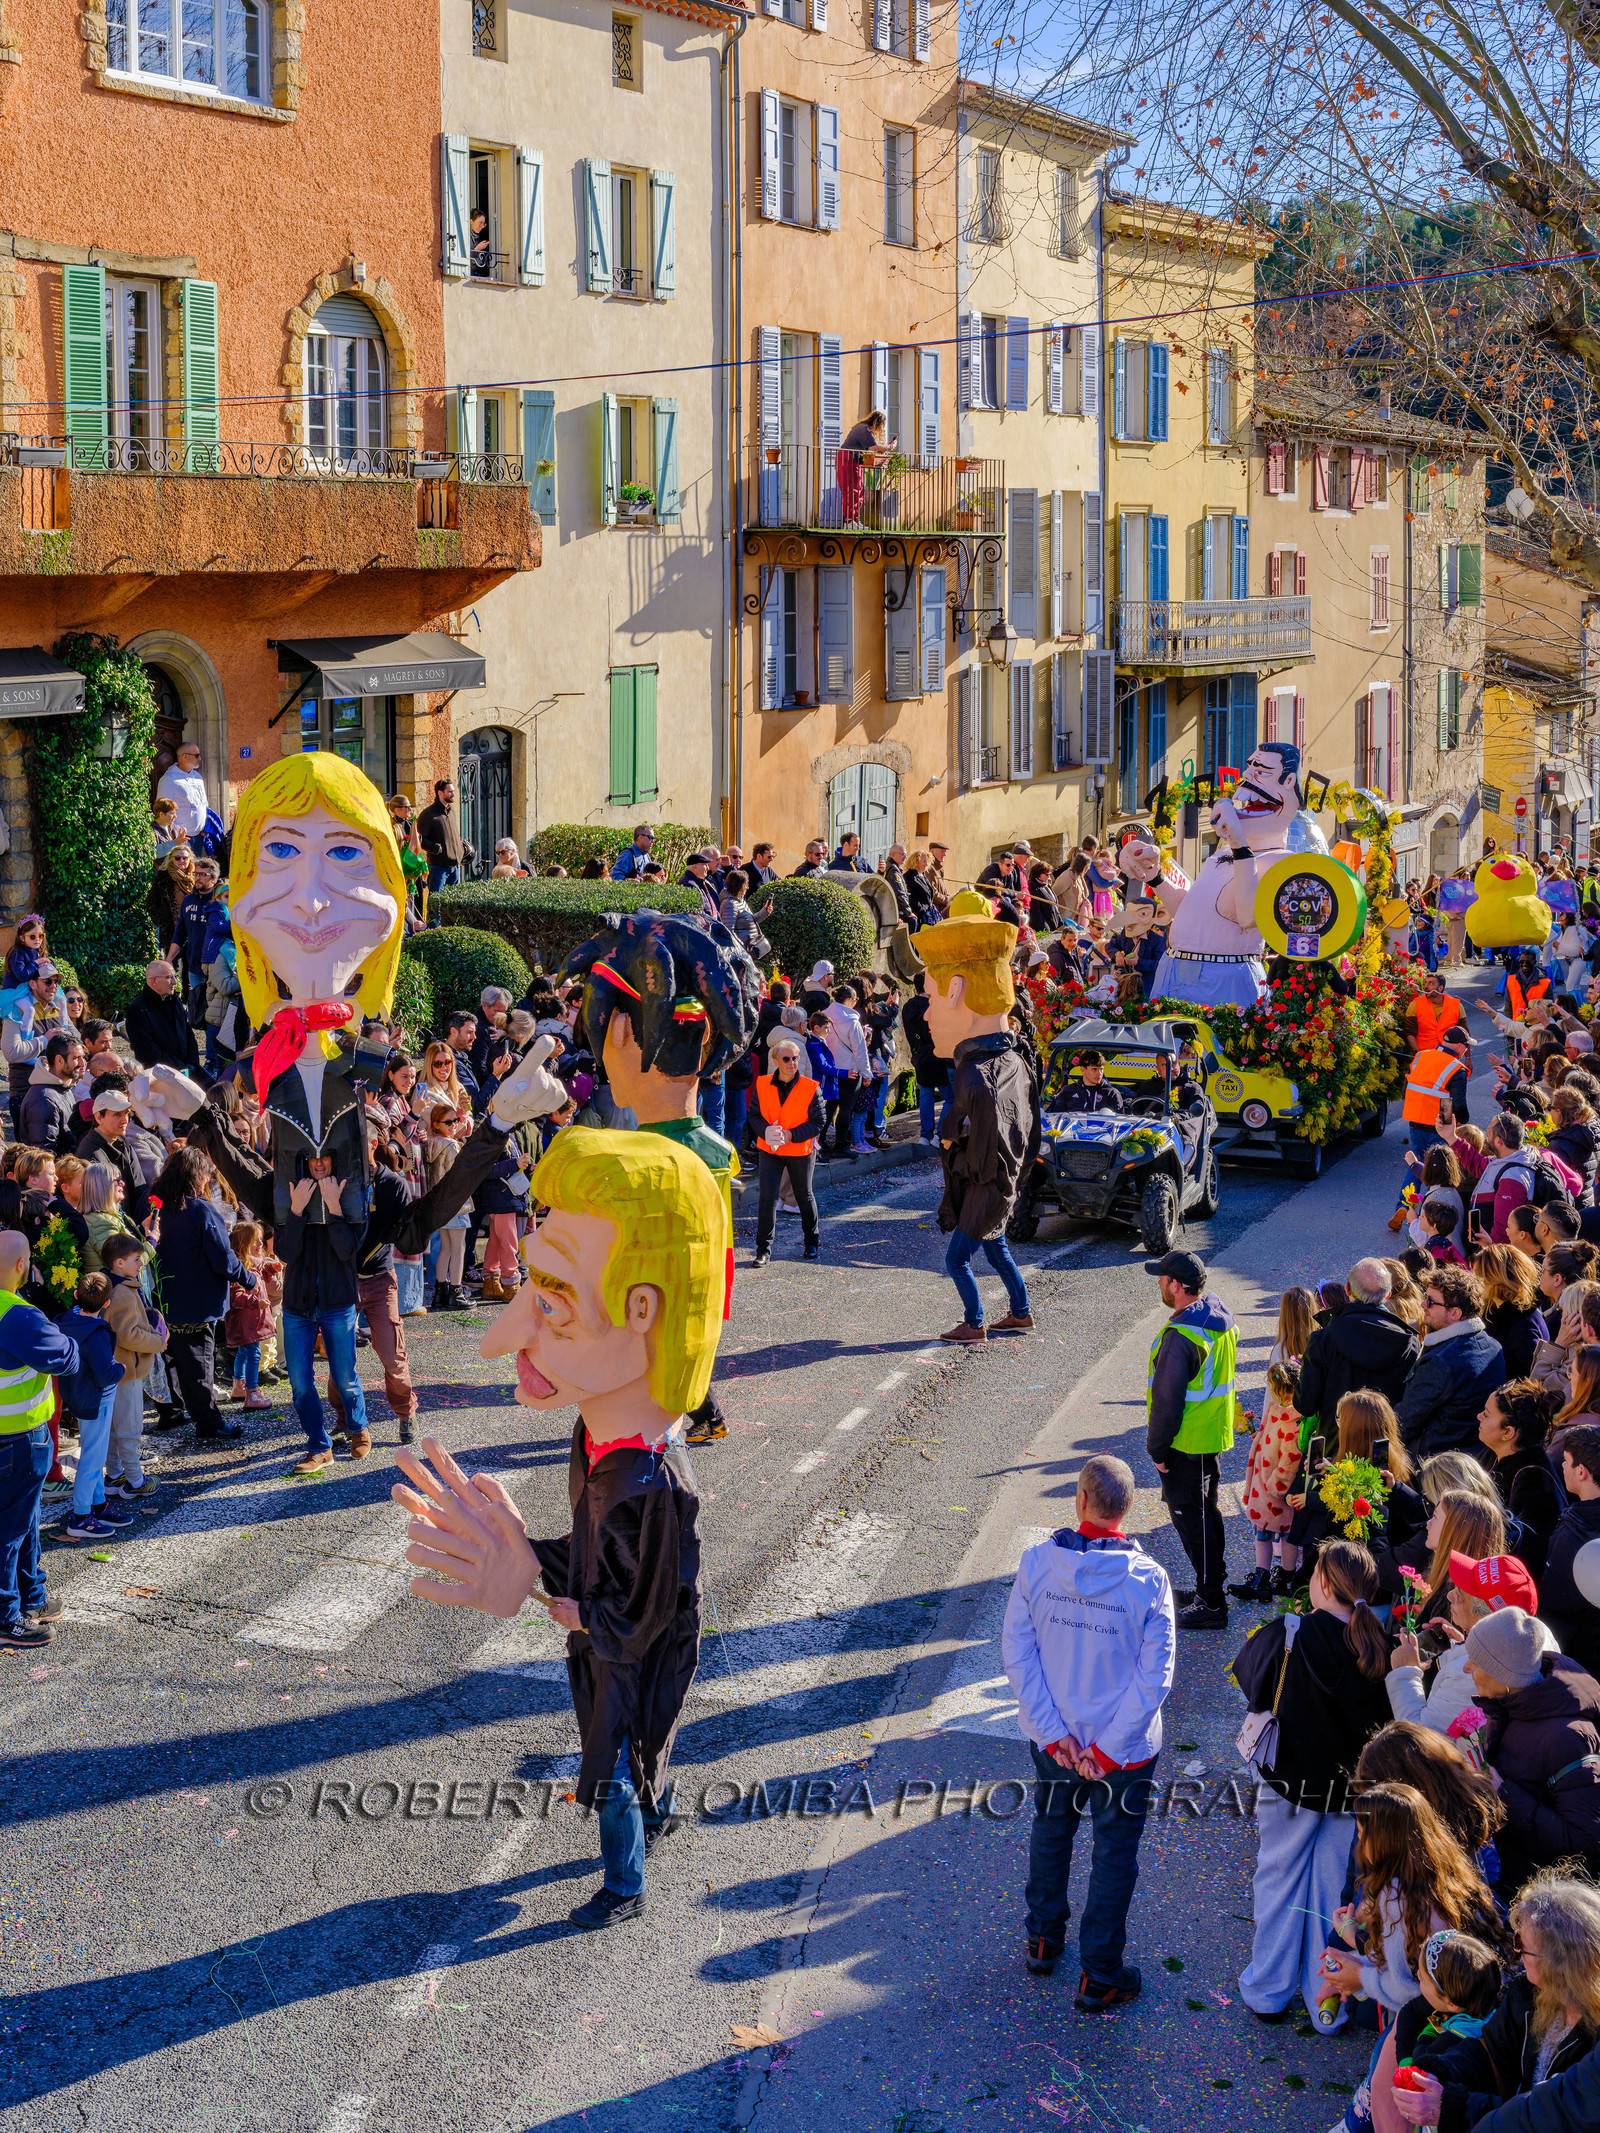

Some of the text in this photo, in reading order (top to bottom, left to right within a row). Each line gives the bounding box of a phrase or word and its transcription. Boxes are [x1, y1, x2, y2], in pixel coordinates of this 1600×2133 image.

[383, 669, 446, 682] MAGREY & SONS
[2, 689, 41, 703] & SONS
[1298, 915, 1312, 926] 50
[1296, 936, 1310, 955] 6
[1221, 1084, 1238, 1092] TAXI
[1478, 1563, 1489, 1585] AGAIN
[1046, 1591, 1127, 1613] Réserve Communale
[1049, 1615, 1120, 1635] de Sécurité Civile
